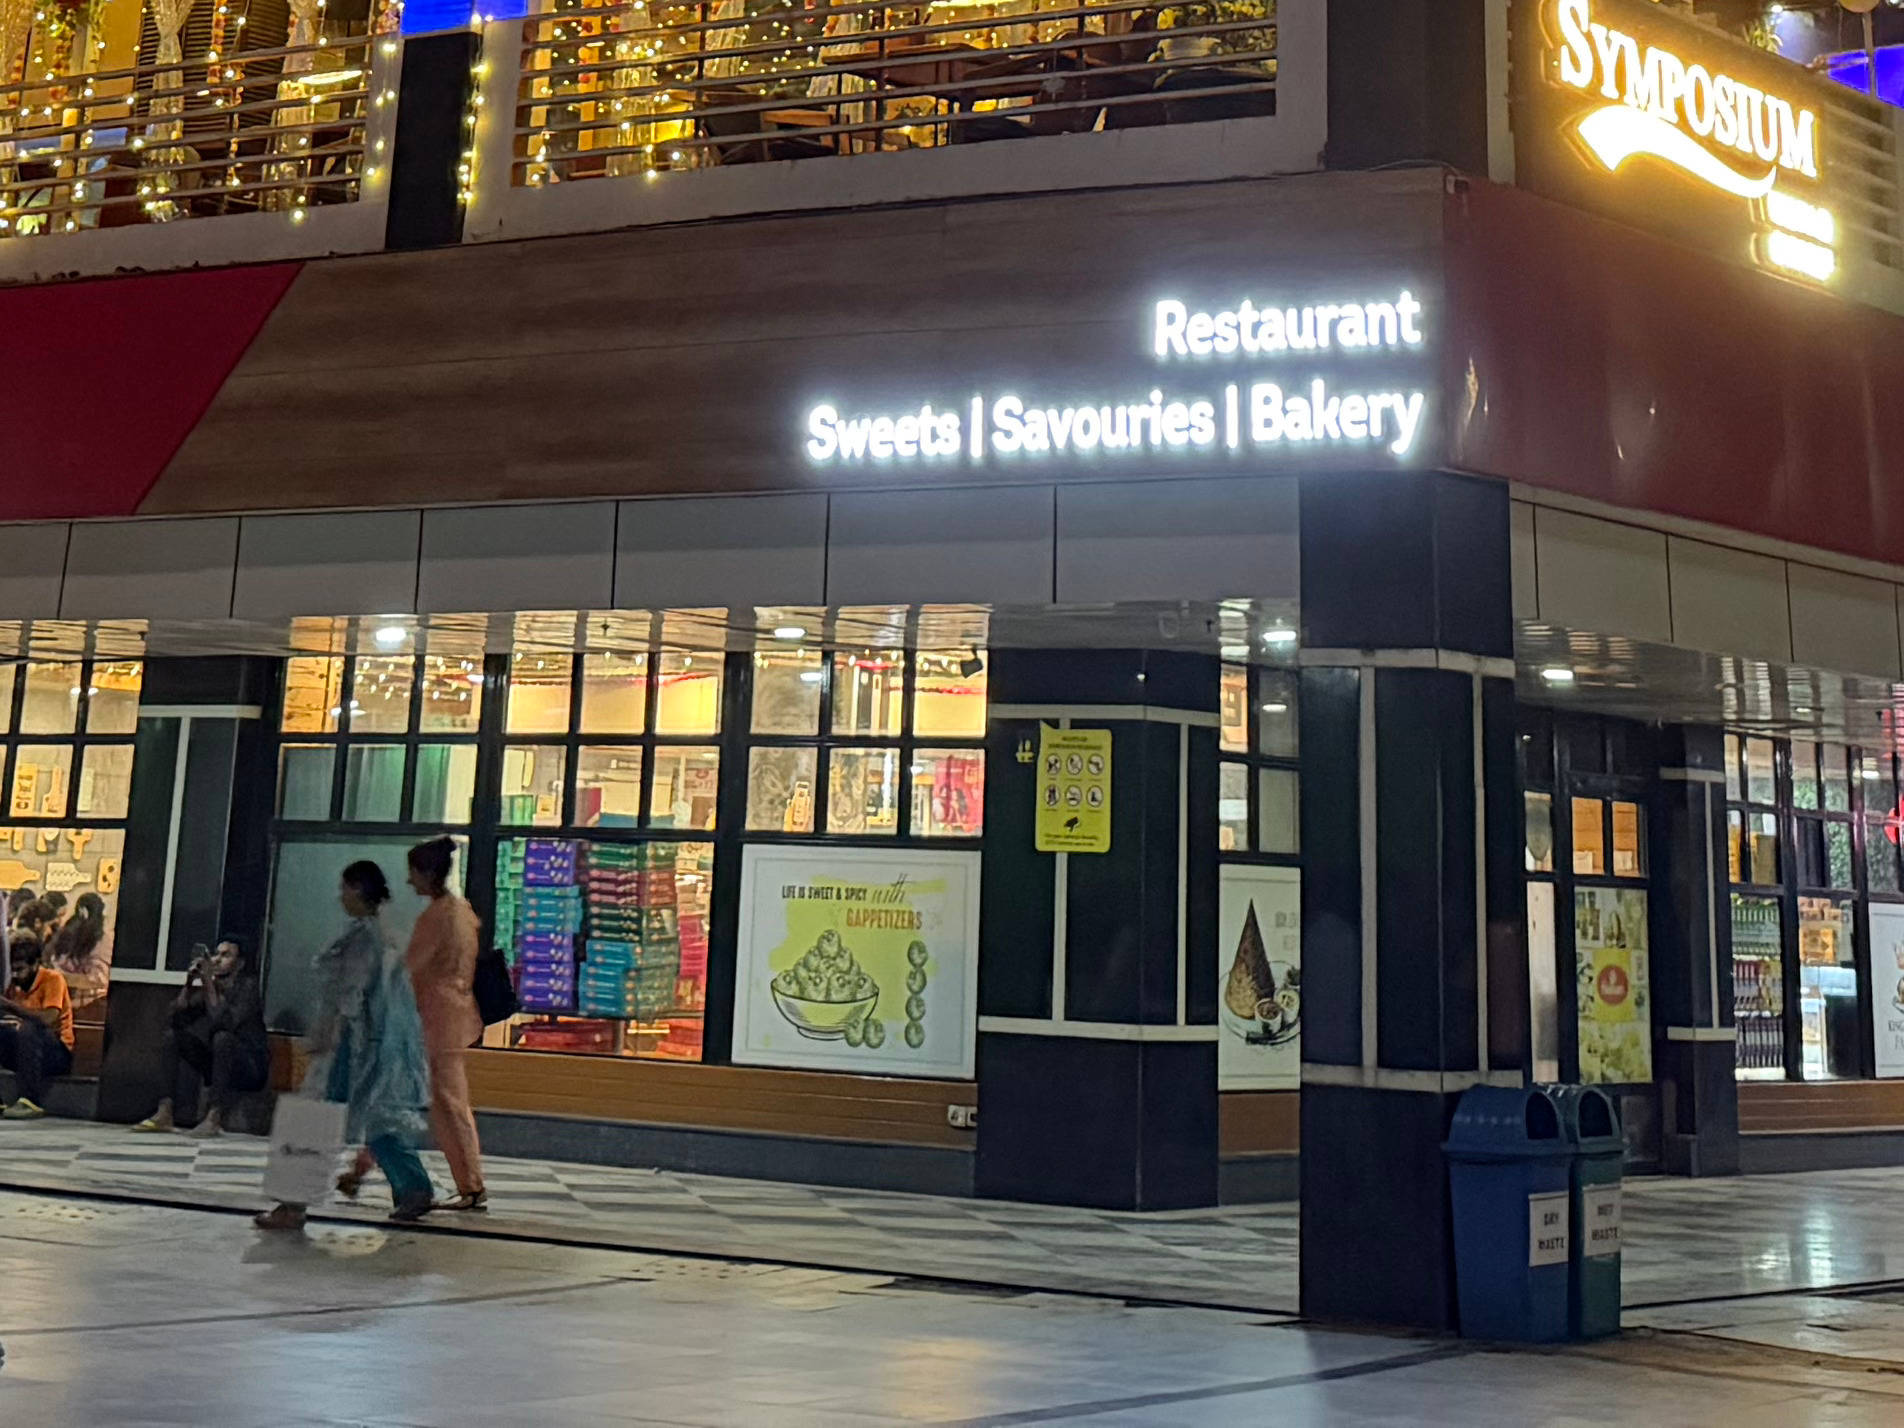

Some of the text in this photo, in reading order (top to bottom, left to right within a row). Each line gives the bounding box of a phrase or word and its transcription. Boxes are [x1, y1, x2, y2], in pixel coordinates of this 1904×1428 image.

[1154, 290, 1423, 357] Restaurant
[806, 402, 961, 462] Sweets
[992, 390, 1215, 453] Savouries
[1250, 379, 1424, 455] Bakery
[782, 885, 796, 899] LIFE
[808, 886, 834, 901] SWEET
[845, 887, 868, 901] SPICY
[846, 907, 923, 930] GAPPETIZERS
